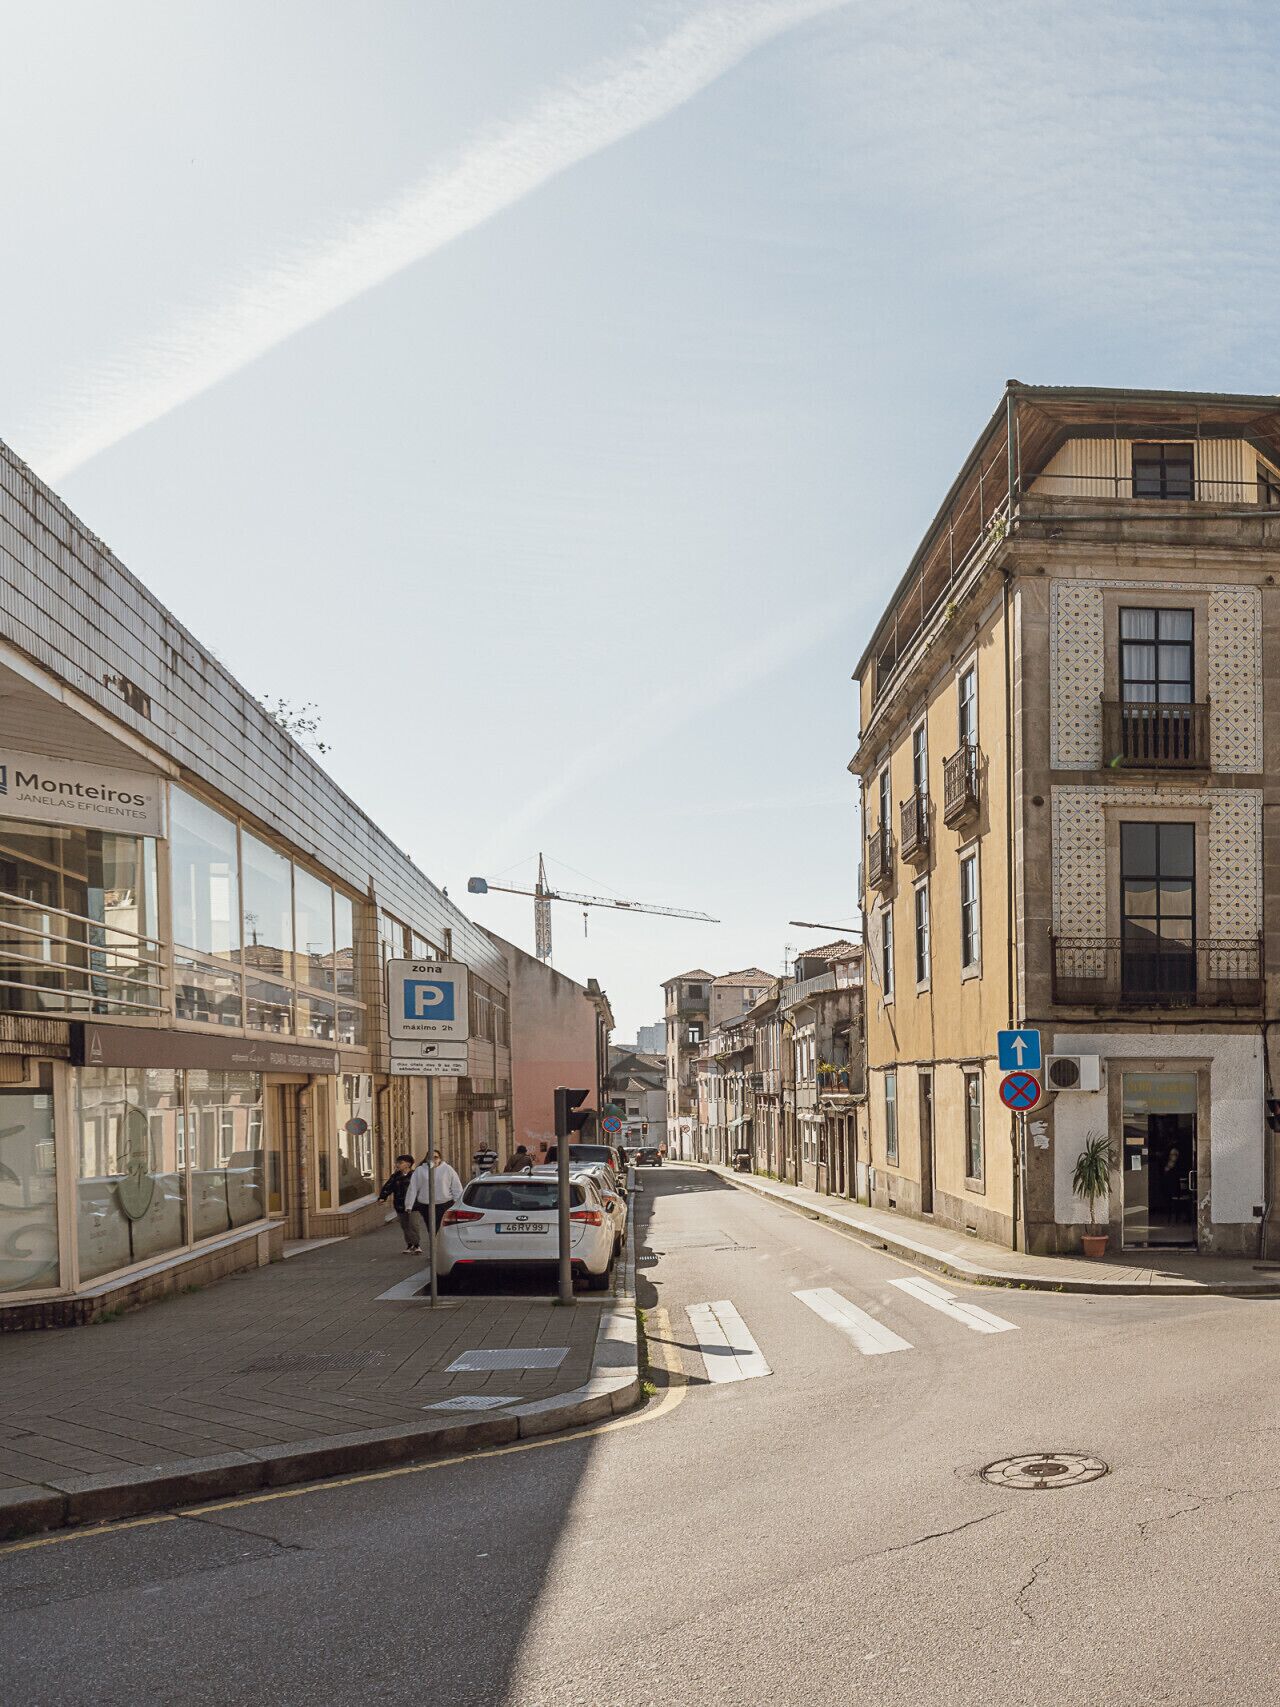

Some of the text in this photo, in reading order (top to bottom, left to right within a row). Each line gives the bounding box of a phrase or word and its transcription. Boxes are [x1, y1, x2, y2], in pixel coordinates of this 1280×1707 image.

[15, 771, 145, 806] Monteiros
[16, 793, 147, 819] JANELAS EFICIENTES
[412, 965, 442, 973] zona
[415, 985, 444, 1016] P
